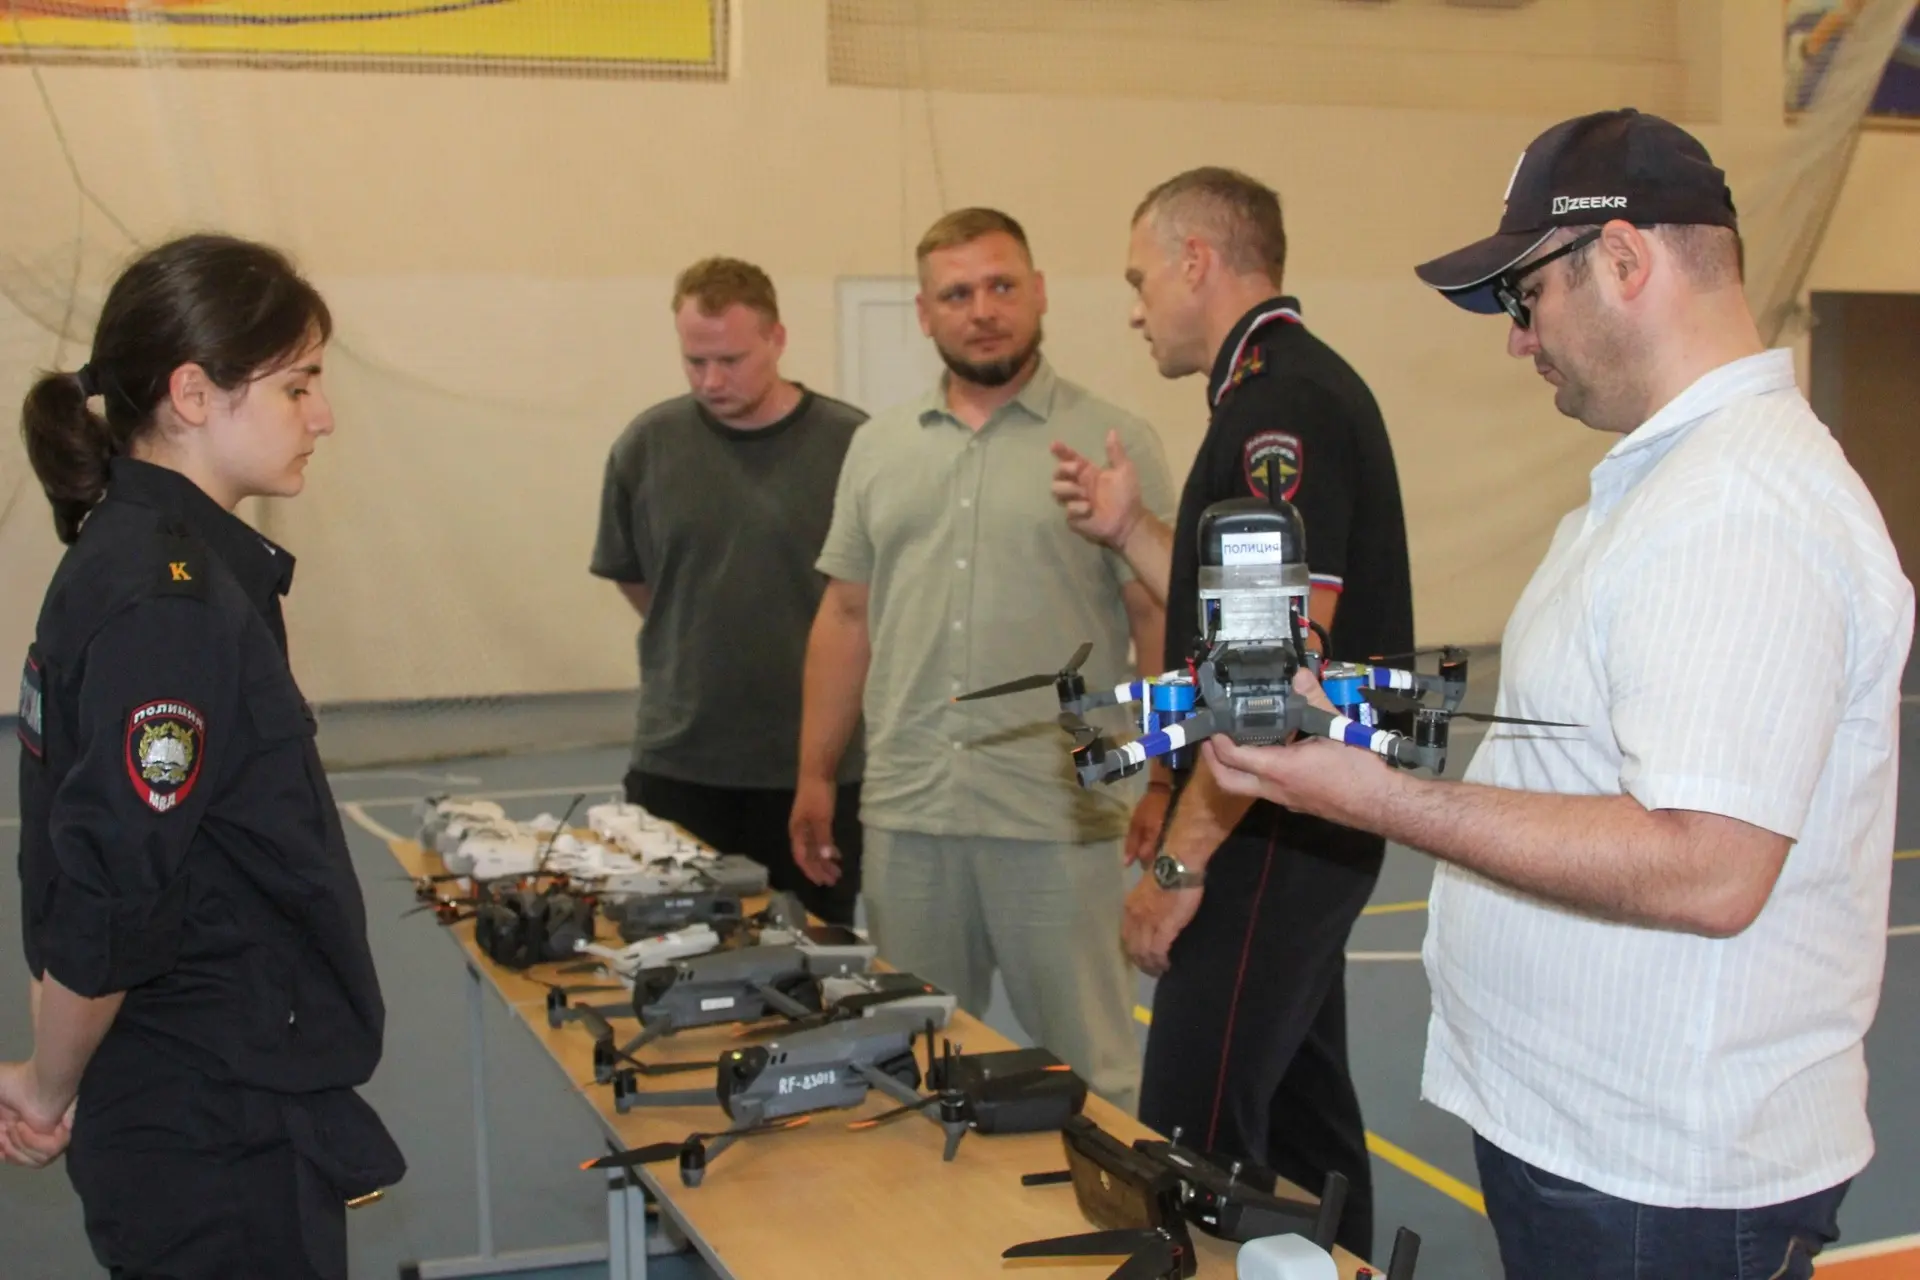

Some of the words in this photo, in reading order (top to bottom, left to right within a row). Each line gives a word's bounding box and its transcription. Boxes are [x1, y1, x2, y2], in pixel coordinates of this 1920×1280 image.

[1568, 196, 1628, 210] ZEEKR
[1223, 543, 1280, 554] ПОЛИЦИЯ
[133, 703, 205, 730] ПОЛИЦИЯ
[149, 789, 177, 812] МВД
